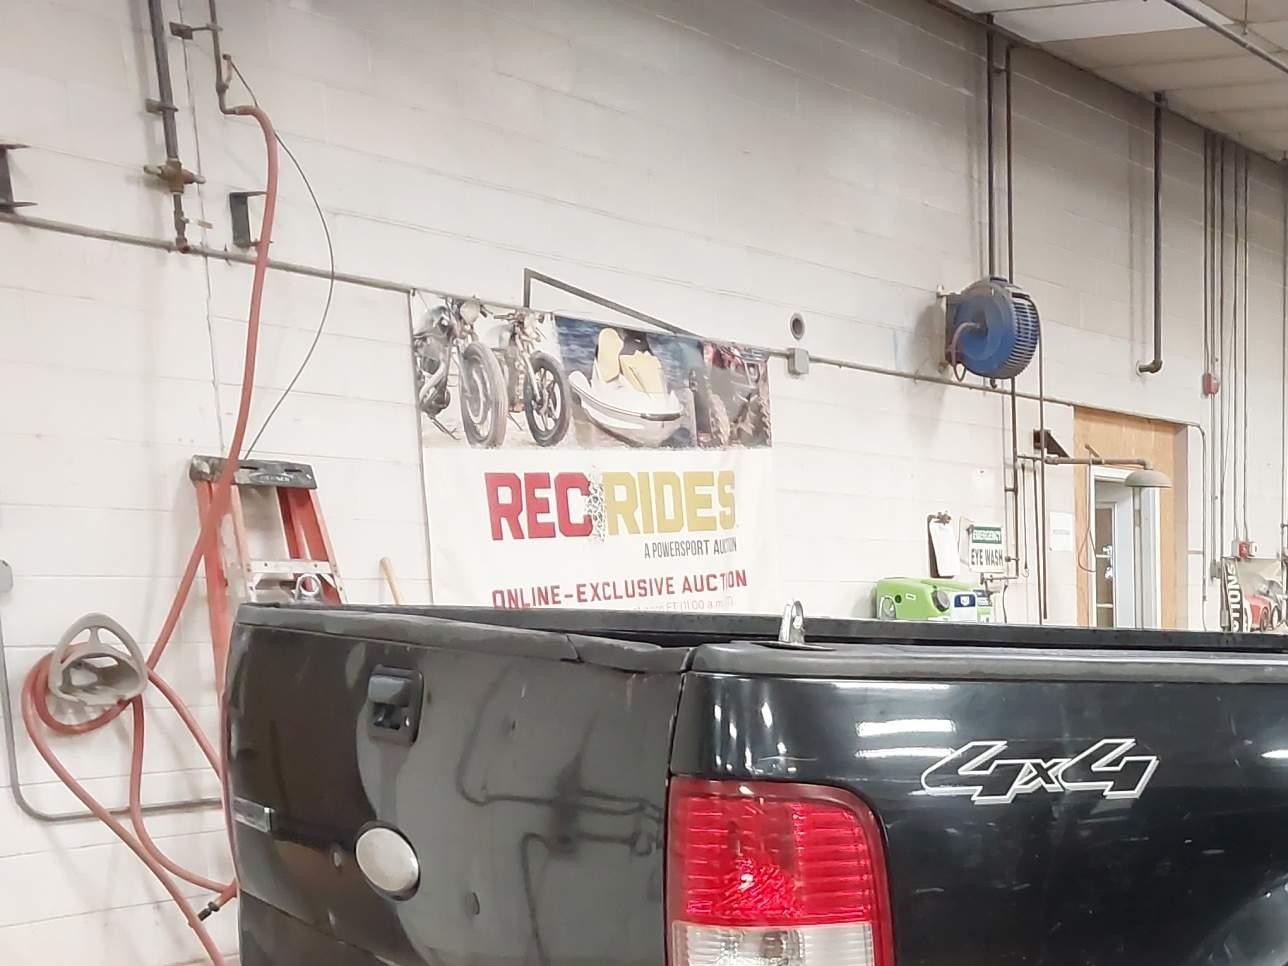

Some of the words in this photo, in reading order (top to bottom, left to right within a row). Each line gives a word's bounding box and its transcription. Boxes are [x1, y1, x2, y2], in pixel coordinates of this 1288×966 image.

[485, 472, 593, 540] REC
[601, 470, 736, 535] RIDES
[644, 542, 650, 559] A
[652, 540, 709, 558] POWERSPORT
[971, 548, 984, 566] EYE
[985, 548, 1004, 567] WASH
[492, 576, 675, 609] ONLINE-EXCLUSIVE
[682, 569, 748, 594] AUCTION
[921, 738, 1160, 805] 4x4
